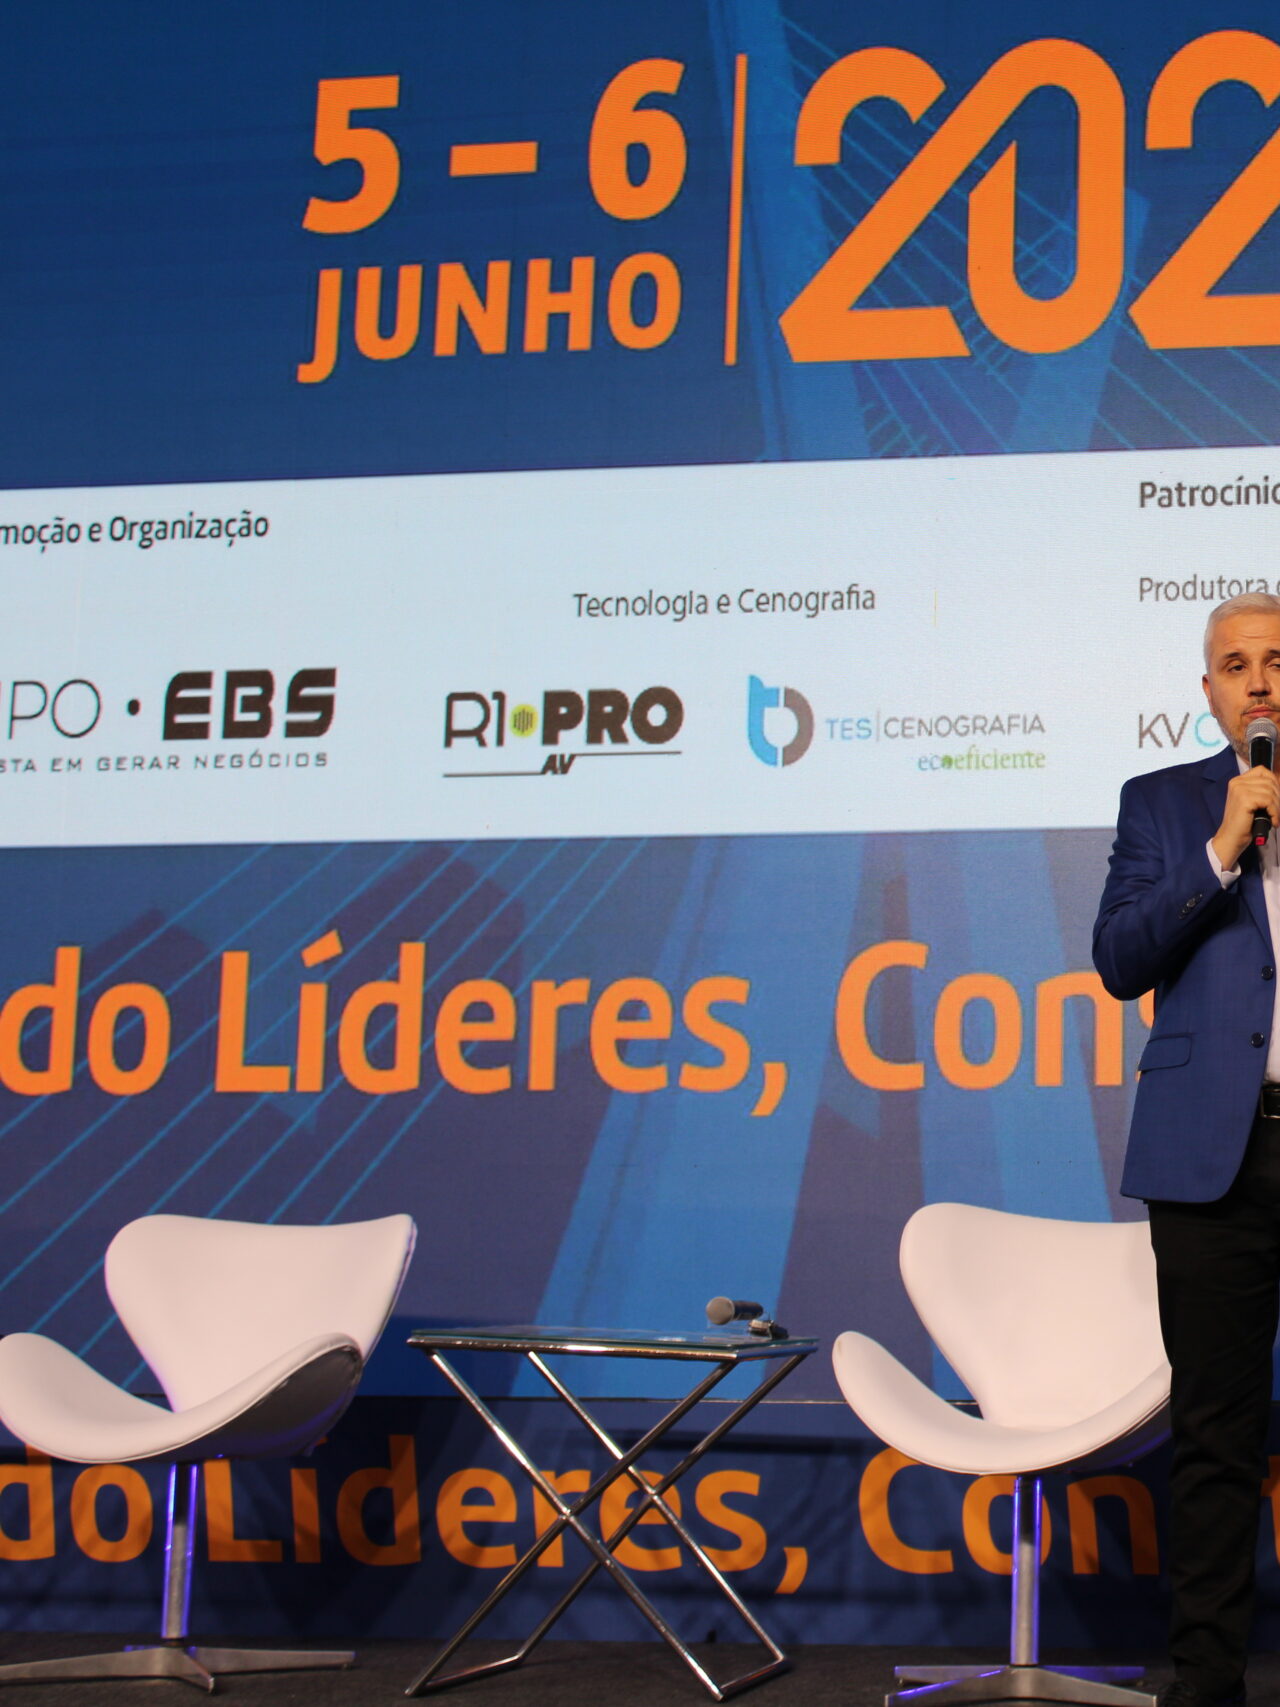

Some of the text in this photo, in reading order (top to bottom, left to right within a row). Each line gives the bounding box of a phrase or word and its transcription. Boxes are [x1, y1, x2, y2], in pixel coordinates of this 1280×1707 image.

[302, 74, 401, 234] 5
[588, 58, 687, 221] 6
[296, 251, 682, 384] JUNHO
[87, 522, 102, 542] e
[109, 511, 269, 549] Organização
[573, 584, 877, 621] Tecnologia e Cenografia
[1138, 574, 1269, 602] Produtora
[0, 667, 337, 741] PO EBS
[541, 686, 685, 747] PRO
[825, 714, 1046, 740] TES CENOGRAFIA
[50, 757, 83, 772] EM
[97, 754, 181, 771] GERAR
[194, 749, 328, 769] NEGÓCIOS
[540, 753, 576, 776] AV
[0, 946, 171, 1095] do
[215, 929, 788, 1117] Líderes,
